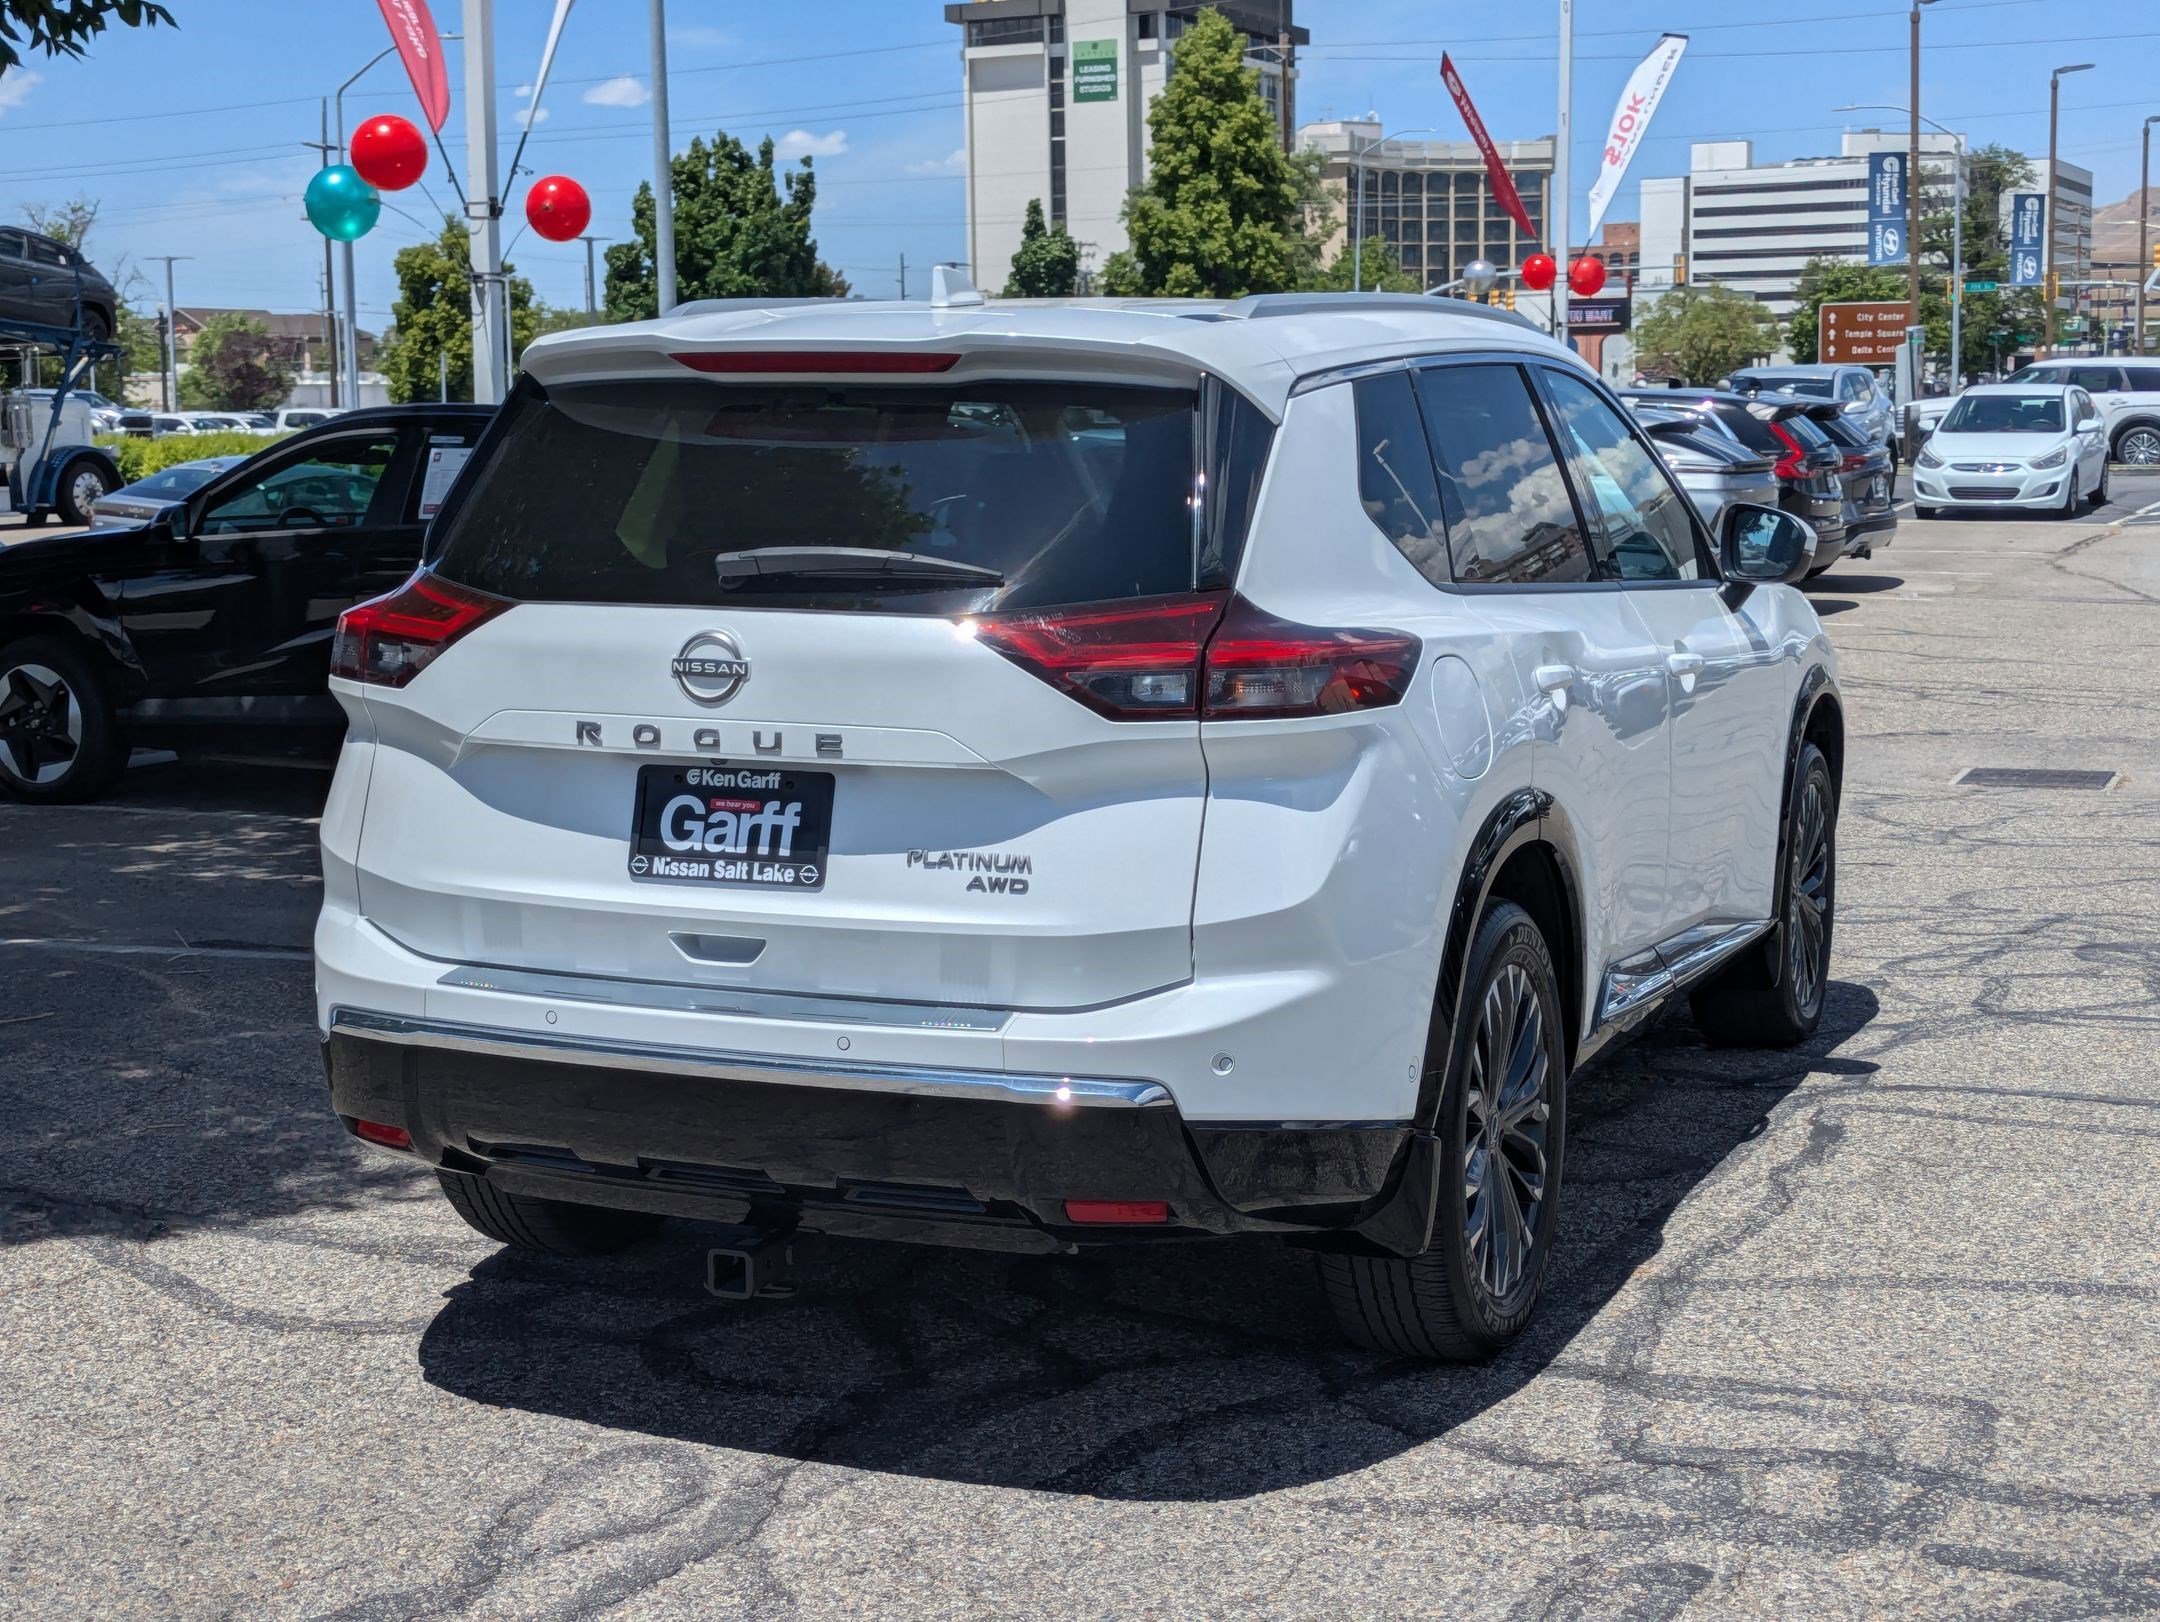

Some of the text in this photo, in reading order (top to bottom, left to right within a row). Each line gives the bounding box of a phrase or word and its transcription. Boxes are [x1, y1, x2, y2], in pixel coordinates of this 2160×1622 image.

[1079, 84, 1112, 93] STUDIOS
[1881, 173, 1892, 214] Hyundai
[2023, 211, 2032, 244] Hyundai
[1875, 224, 1883, 261] HYUNDAI
[1857, 313, 1904, 322] City Center
[1845, 329, 1904, 338] Temple Square
[1852, 345, 1896, 354] Delta Cent
[672, 660, 746, 675] NISSAN
[576, 720, 843, 758] ROGUE
[702, 769, 782, 790] Ken Garff
[726, 800, 742, 808] hear
[742, 802, 756, 810] you
[660, 795, 802, 857] Garff
[652, 856, 795, 883] Nissan Salt Lake
[906, 849, 1033, 875] PLATINUM
[966, 875, 1029, 896] AWD
[1516, 926, 1554, 979] DUNLOP
